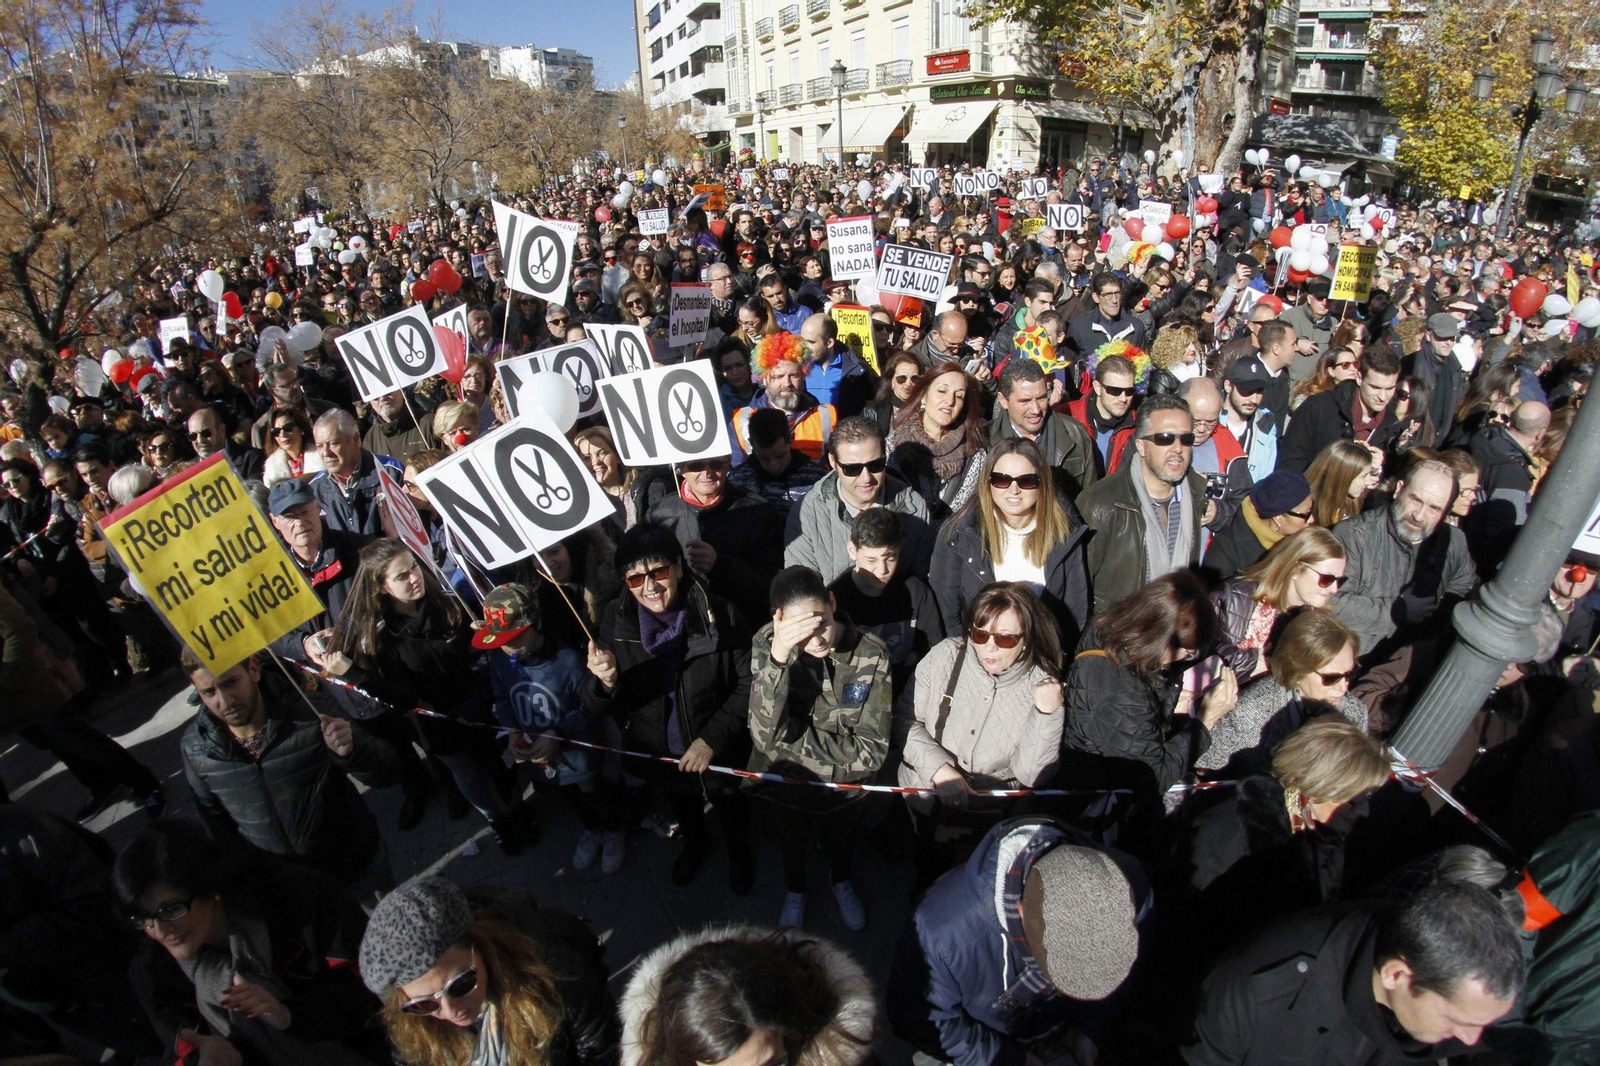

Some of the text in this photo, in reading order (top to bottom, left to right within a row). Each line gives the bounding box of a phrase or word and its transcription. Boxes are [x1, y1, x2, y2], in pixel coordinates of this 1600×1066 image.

[940, 57, 959, 65] Santander
[774, 170, 787, 179] NO
[975, 172, 998, 189] NO
[955, 178, 975, 194] NO
[1023, 180, 1046, 197] NO
[639, 210, 667, 221] SE VENDE
[1049, 206, 1080, 228] NO
[641, 222, 648, 232] TU
[830, 225, 872, 239] Susana,
[832, 242, 873, 256] no sana
[1340, 250, 1376, 265] RECORTES
[833, 258, 874, 276] ¡NADA!
[886, 247, 951, 273] SE VENDE
[884, 268, 940, 295] TU SALUD.
[1334, 281, 1342, 292] EN
[672, 293, 710, 315] ¡Desmantelan
[672, 317, 709, 338] el hospital!
[341, 316, 435, 396] NO
[602, 369, 718, 459] NO
[427, 428, 590, 564] NO
[120, 475, 237, 573] ¡Recortan
[156, 515, 267, 611] mi salud
[190, 561, 299, 661] y mi vida!
[484, 606, 509, 627] NY
[515, 691, 551, 727] 03
